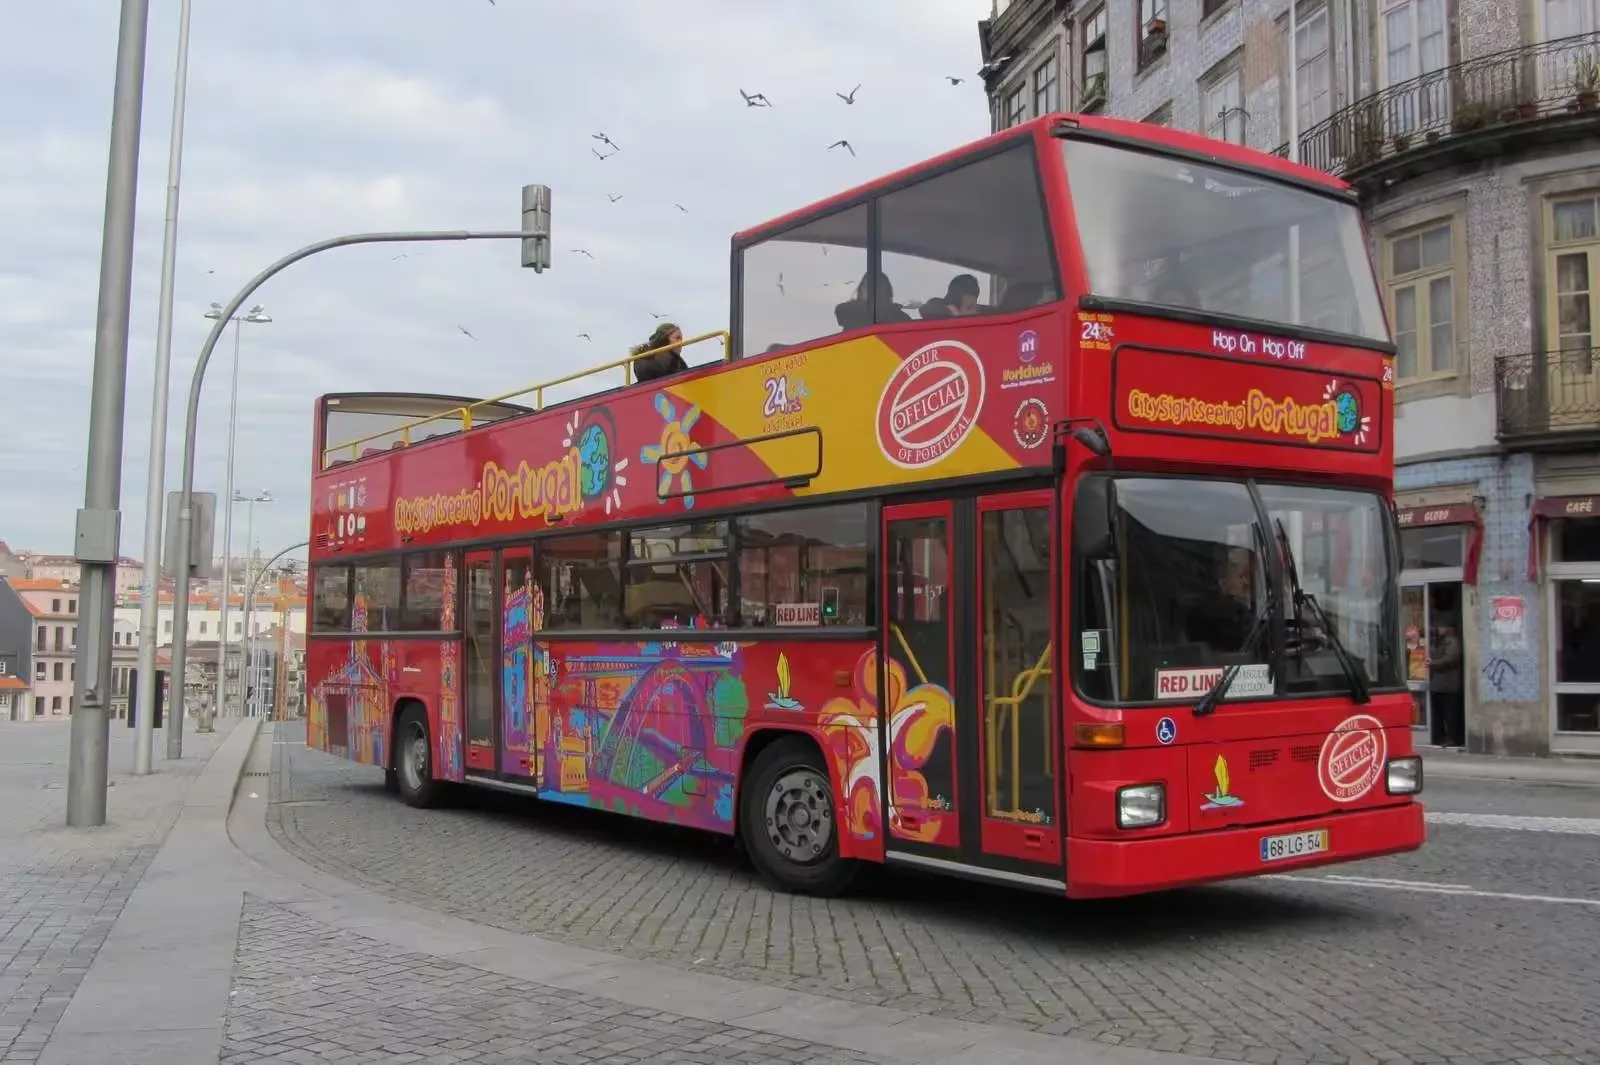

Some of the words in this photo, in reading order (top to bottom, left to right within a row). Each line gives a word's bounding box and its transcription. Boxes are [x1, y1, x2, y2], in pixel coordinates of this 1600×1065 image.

[1082, 322, 1100, 340] 24
[1213, 331, 1236, 352] Hop
[1240, 334, 1255, 353] On
[1262, 338, 1285, 359] Hop
[1288, 341, 1304, 359] Off
[903, 349, 940, 376] TOUR
[1383, 366, 1392, 381] 24
[764, 375, 787, 418] 24
[893, 380, 965, 431] OFFICIAL
[1128, 389, 1246, 430] CitySightseeing
[1248, 388, 1338, 444] Portugal
[898, 449, 913, 462] OF
[916, 415, 972, 461] PORTUGAL
[395, 488, 480, 534] CitySightseeing
[483, 447, 582, 526] Portugal
[1566, 498, 1592, 513] CAFÉ
[777, 607, 796, 621] RED
[797, 607, 818, 621] LINE
[1160, 675, 1188, 693] RED
